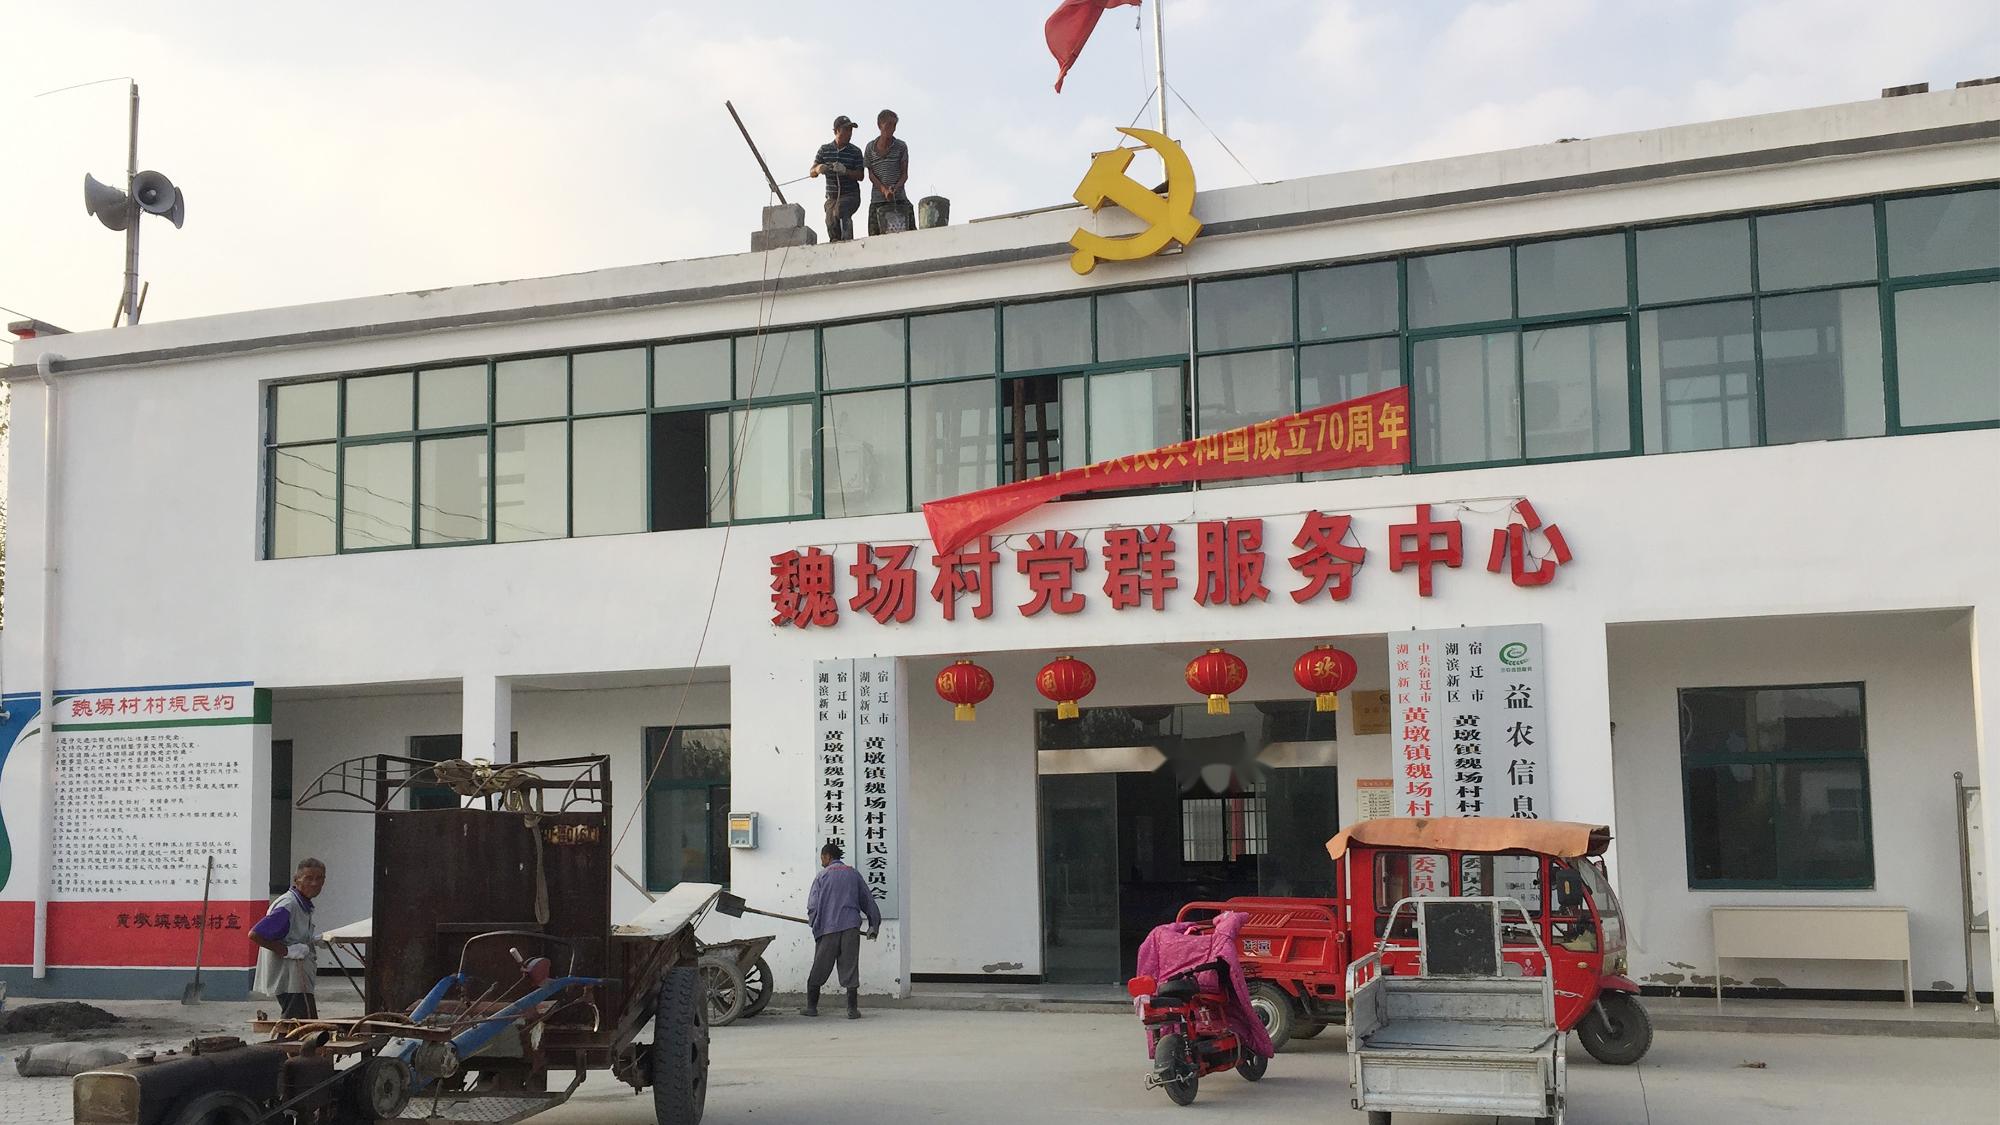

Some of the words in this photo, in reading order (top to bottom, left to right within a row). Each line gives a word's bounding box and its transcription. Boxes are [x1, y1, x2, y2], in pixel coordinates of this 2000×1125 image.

[1055, 403, 1409, 480] 人民共和国成立70周年
[771, 497, 1574, 628] 魏场村党群服务中心
[818, 672, 829, 722] 湖滨新区
[837, 671, 848, 722] 宿迁市
[859, 671, 871, 725] 湖滨新区
[877, 670, 889, 725] 宿迁市
[1396, 643, 1411, 704] 湖滨新区
[1418, 642, 1432, 703] 中共宿迁市
[1445, 643, 1461, 703] 湖滨新区
[1468, 641, 1485, 703] 宿迁市
[824, 730, 846, 859] 黄墩镇魏场村村级土地
[864, 737, 889, 900] 黄墩镇魏场村村民委员会
